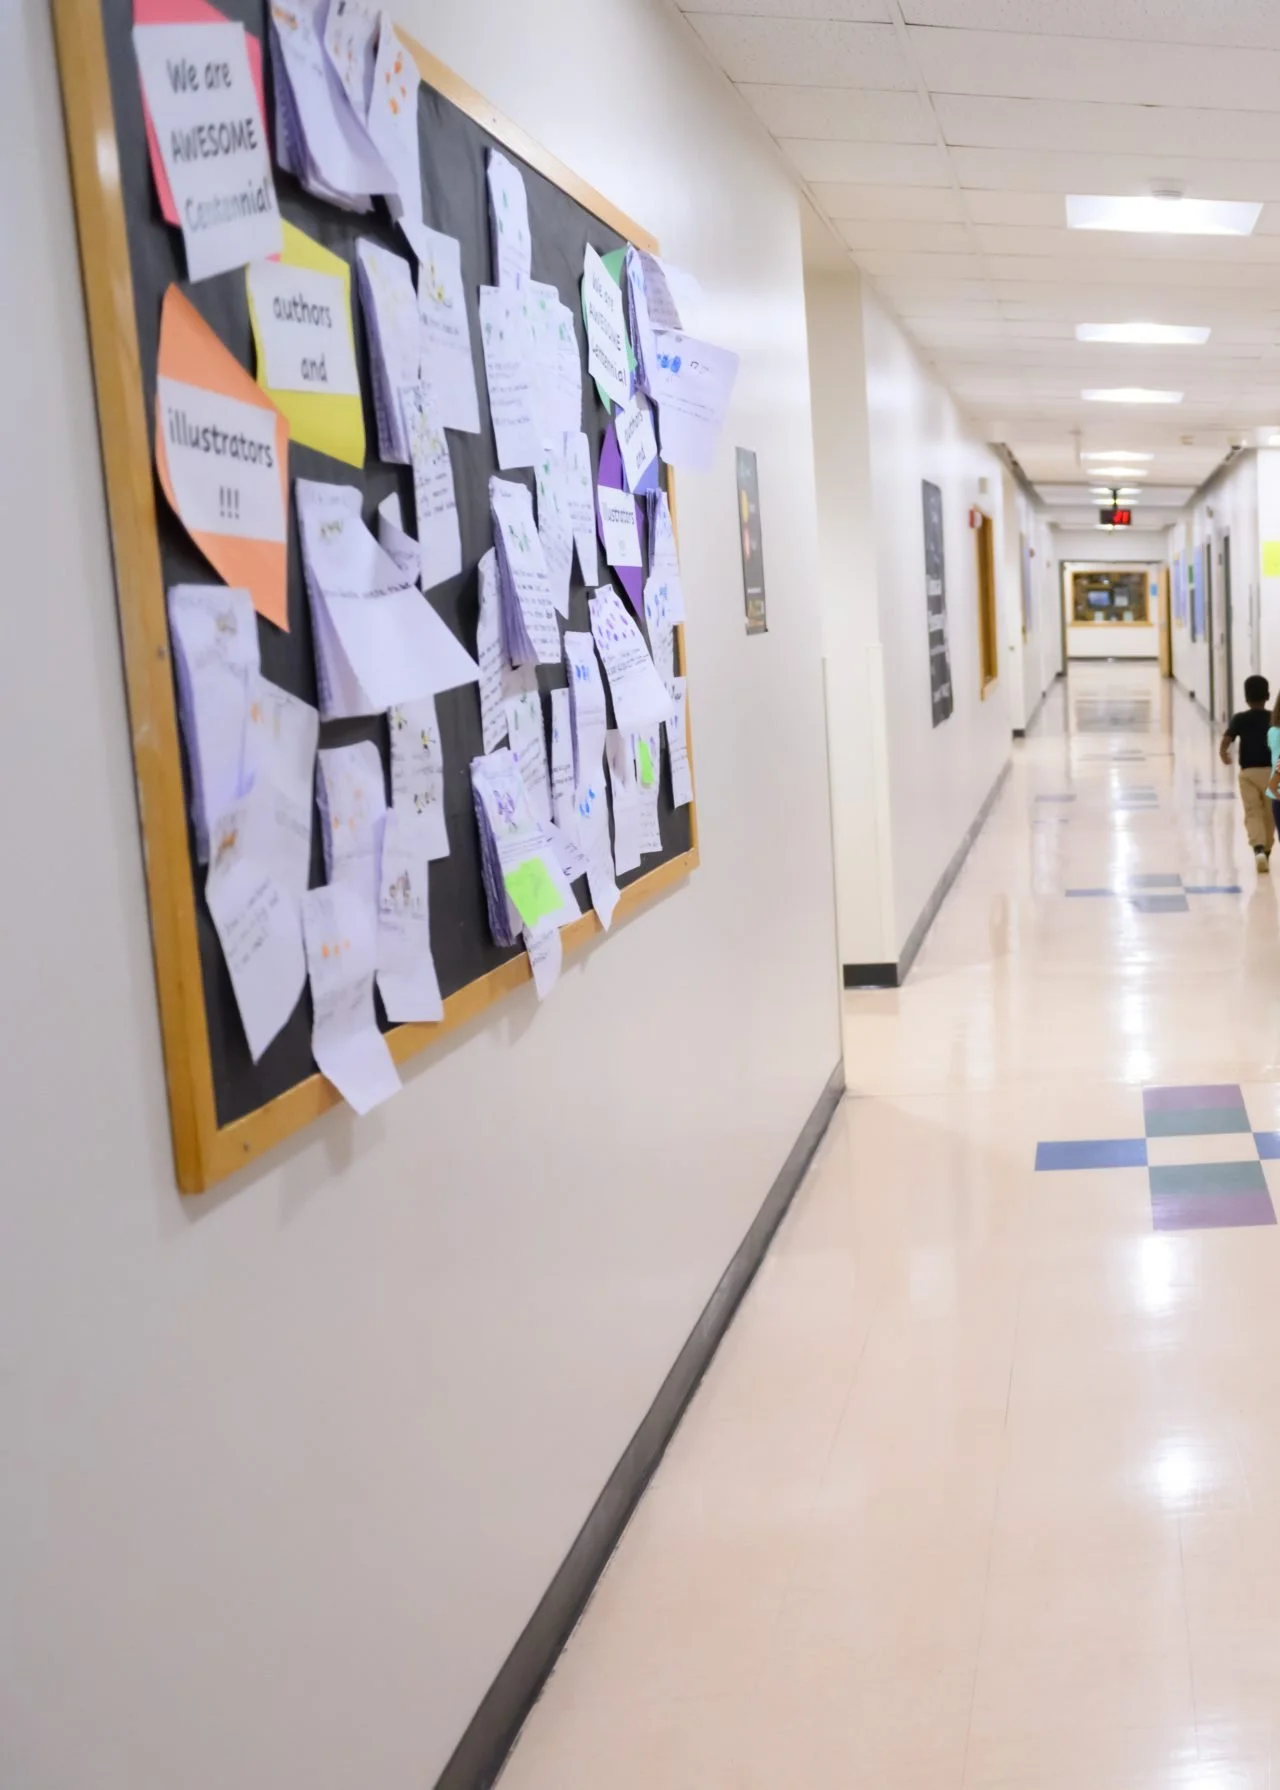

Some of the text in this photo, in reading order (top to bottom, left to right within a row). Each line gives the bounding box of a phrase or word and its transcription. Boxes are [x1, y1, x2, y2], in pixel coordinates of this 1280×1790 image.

[166, 58, 232, 94] We are
[171, 118, 258, 163] AWESOME
[273, 293, 333, 329] authors
[300, 352, 328, 384] and
[167, 406, 274, 468] illustrators
